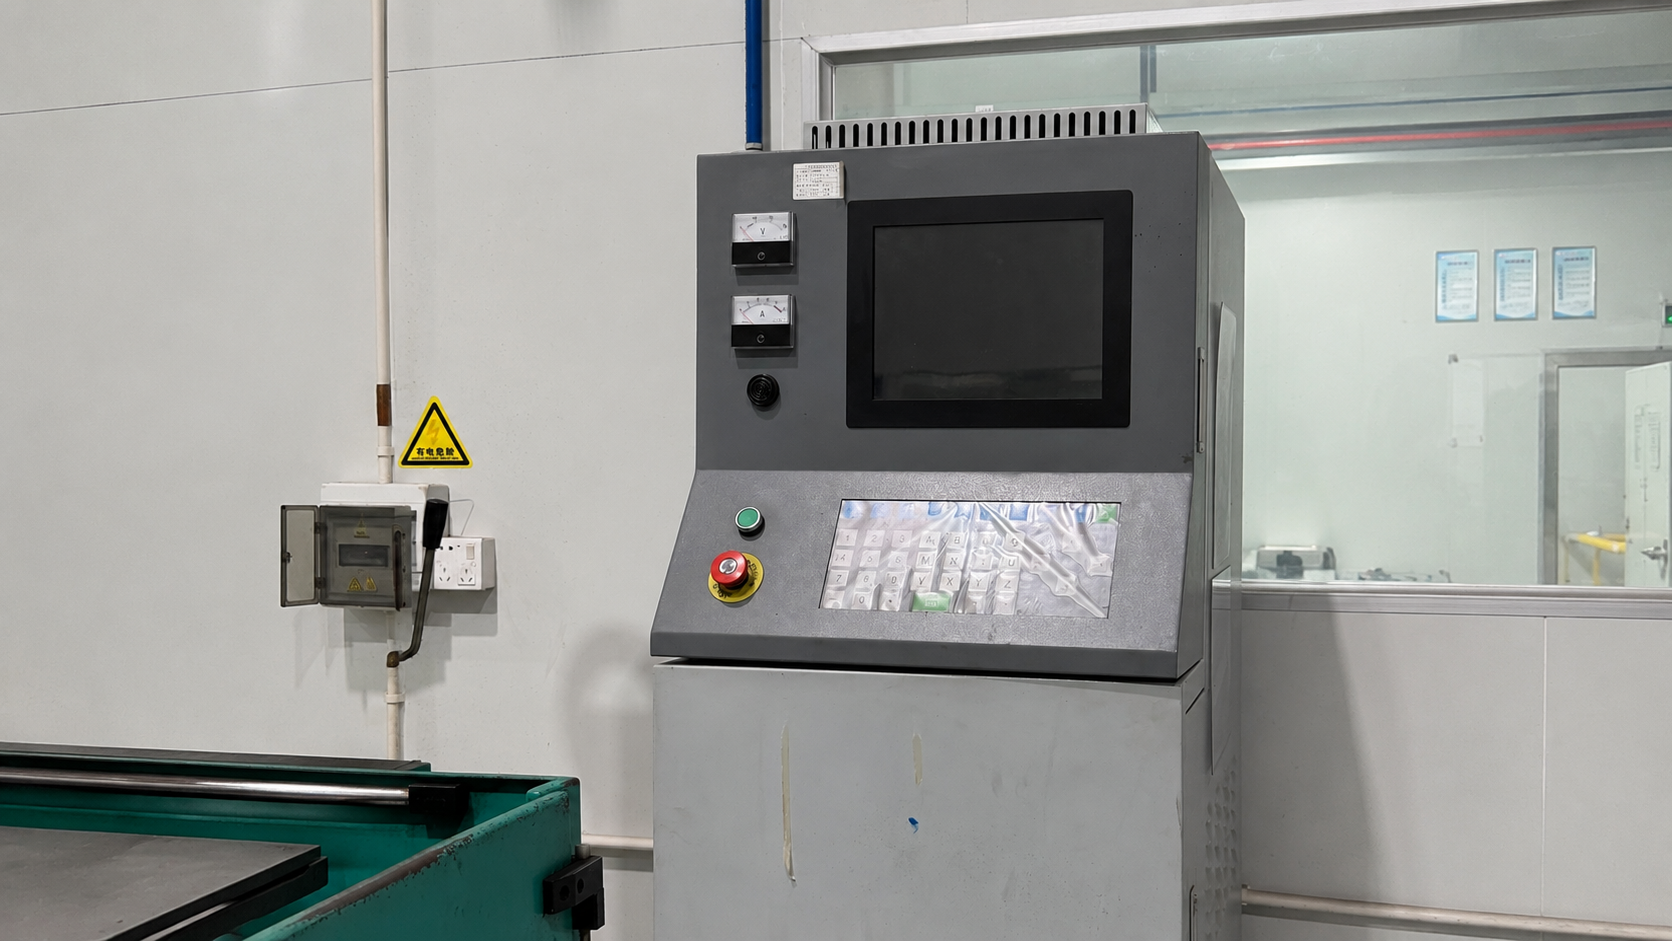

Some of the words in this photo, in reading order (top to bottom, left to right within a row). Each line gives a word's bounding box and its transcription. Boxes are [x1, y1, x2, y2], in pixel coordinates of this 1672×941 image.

[759, 310, 765, 318] A
[921, 556, 931, 565] M
[946, 577, 954, 586] X
[975, 578, 982, 587] Y
[1003, 580, 1012, 589] Z
